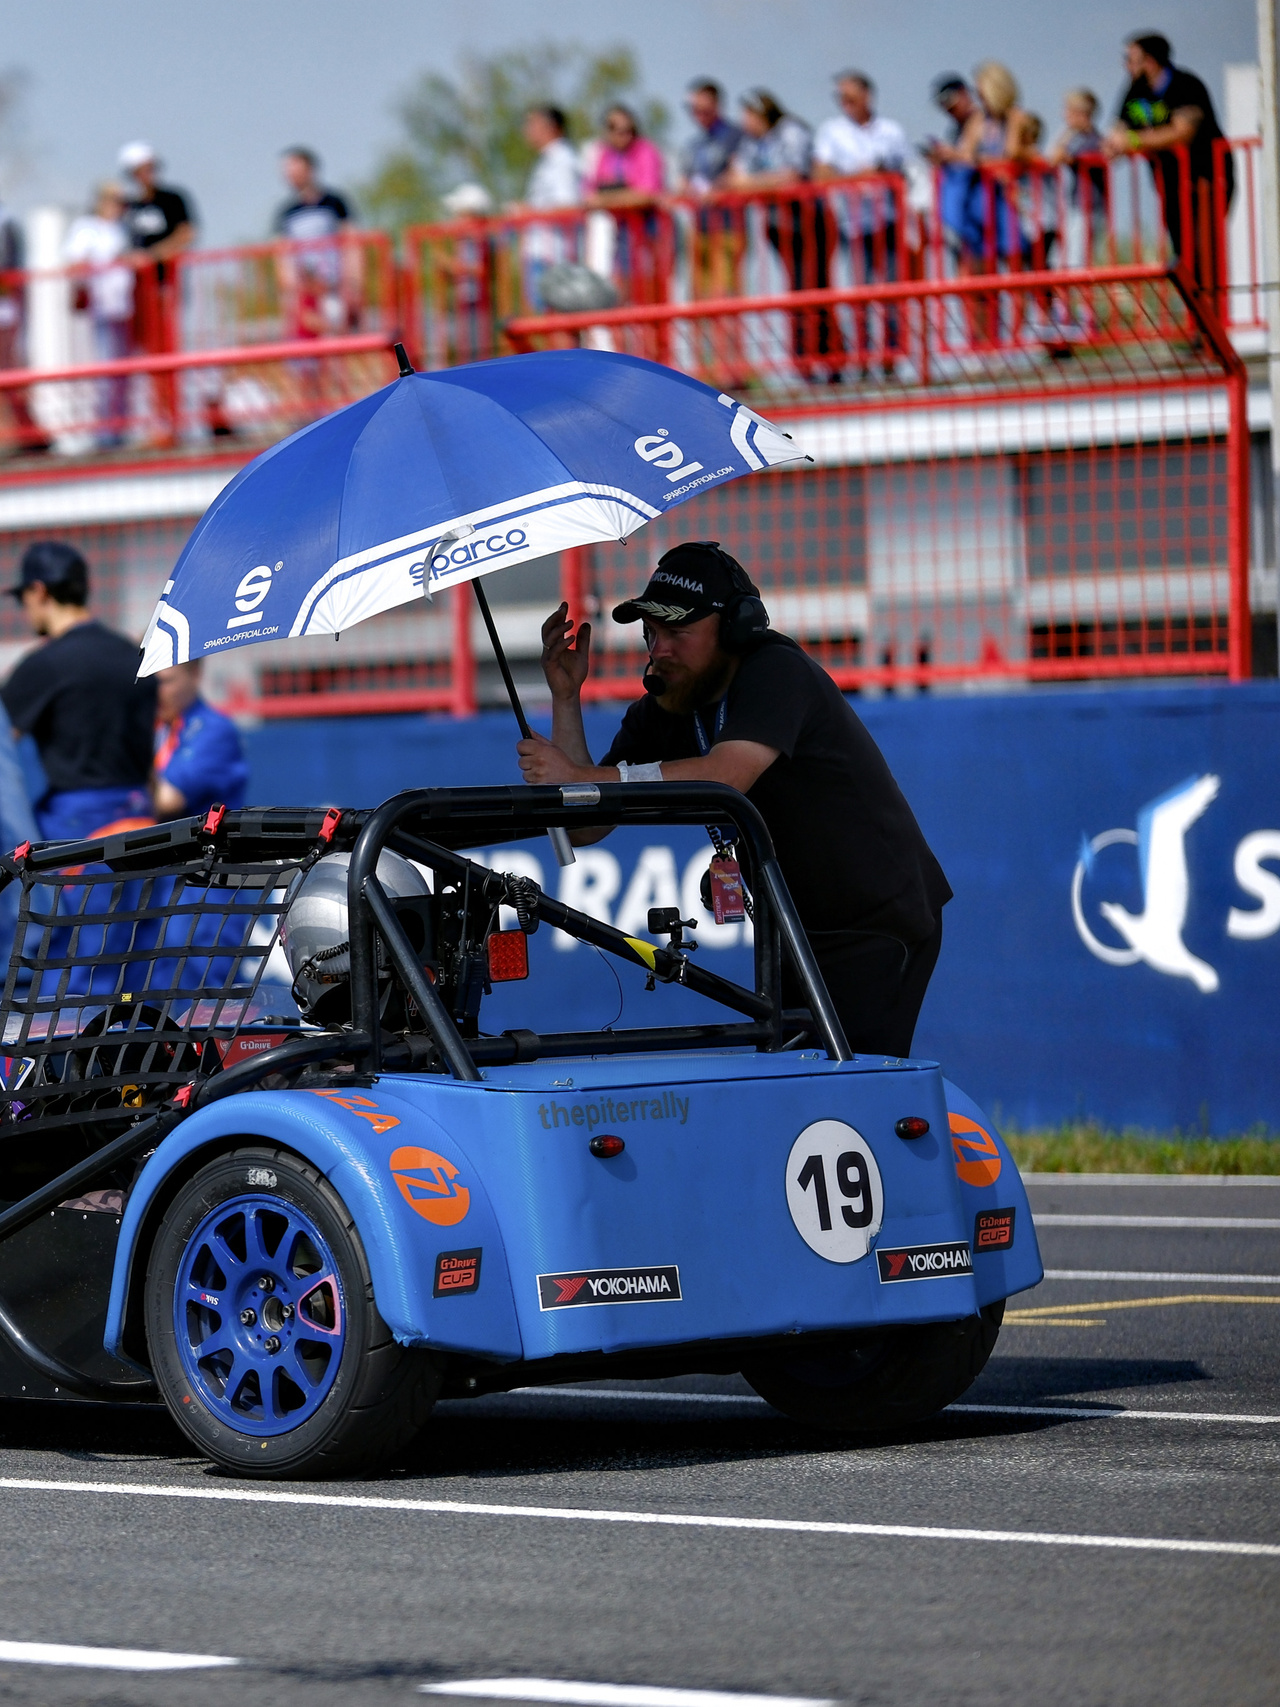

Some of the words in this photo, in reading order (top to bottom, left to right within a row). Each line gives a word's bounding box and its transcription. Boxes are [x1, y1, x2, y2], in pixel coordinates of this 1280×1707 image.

[662, 465, 735, 502] SPARCO-OFFICIAL.COM
[409, 528, 527, 580] sparco
[203, 625, 280, 650] SPARCO-OFFICIAL.COM
[538, 1091, 689, 1132] thepiterrally
[797, 1151, 873, 1231] 19
[981, 1230, 1007, 1242] CUP
[441, 1272, 472, 1285] CUP
[587, 1273, 671, 1296] YOKOHAMA
